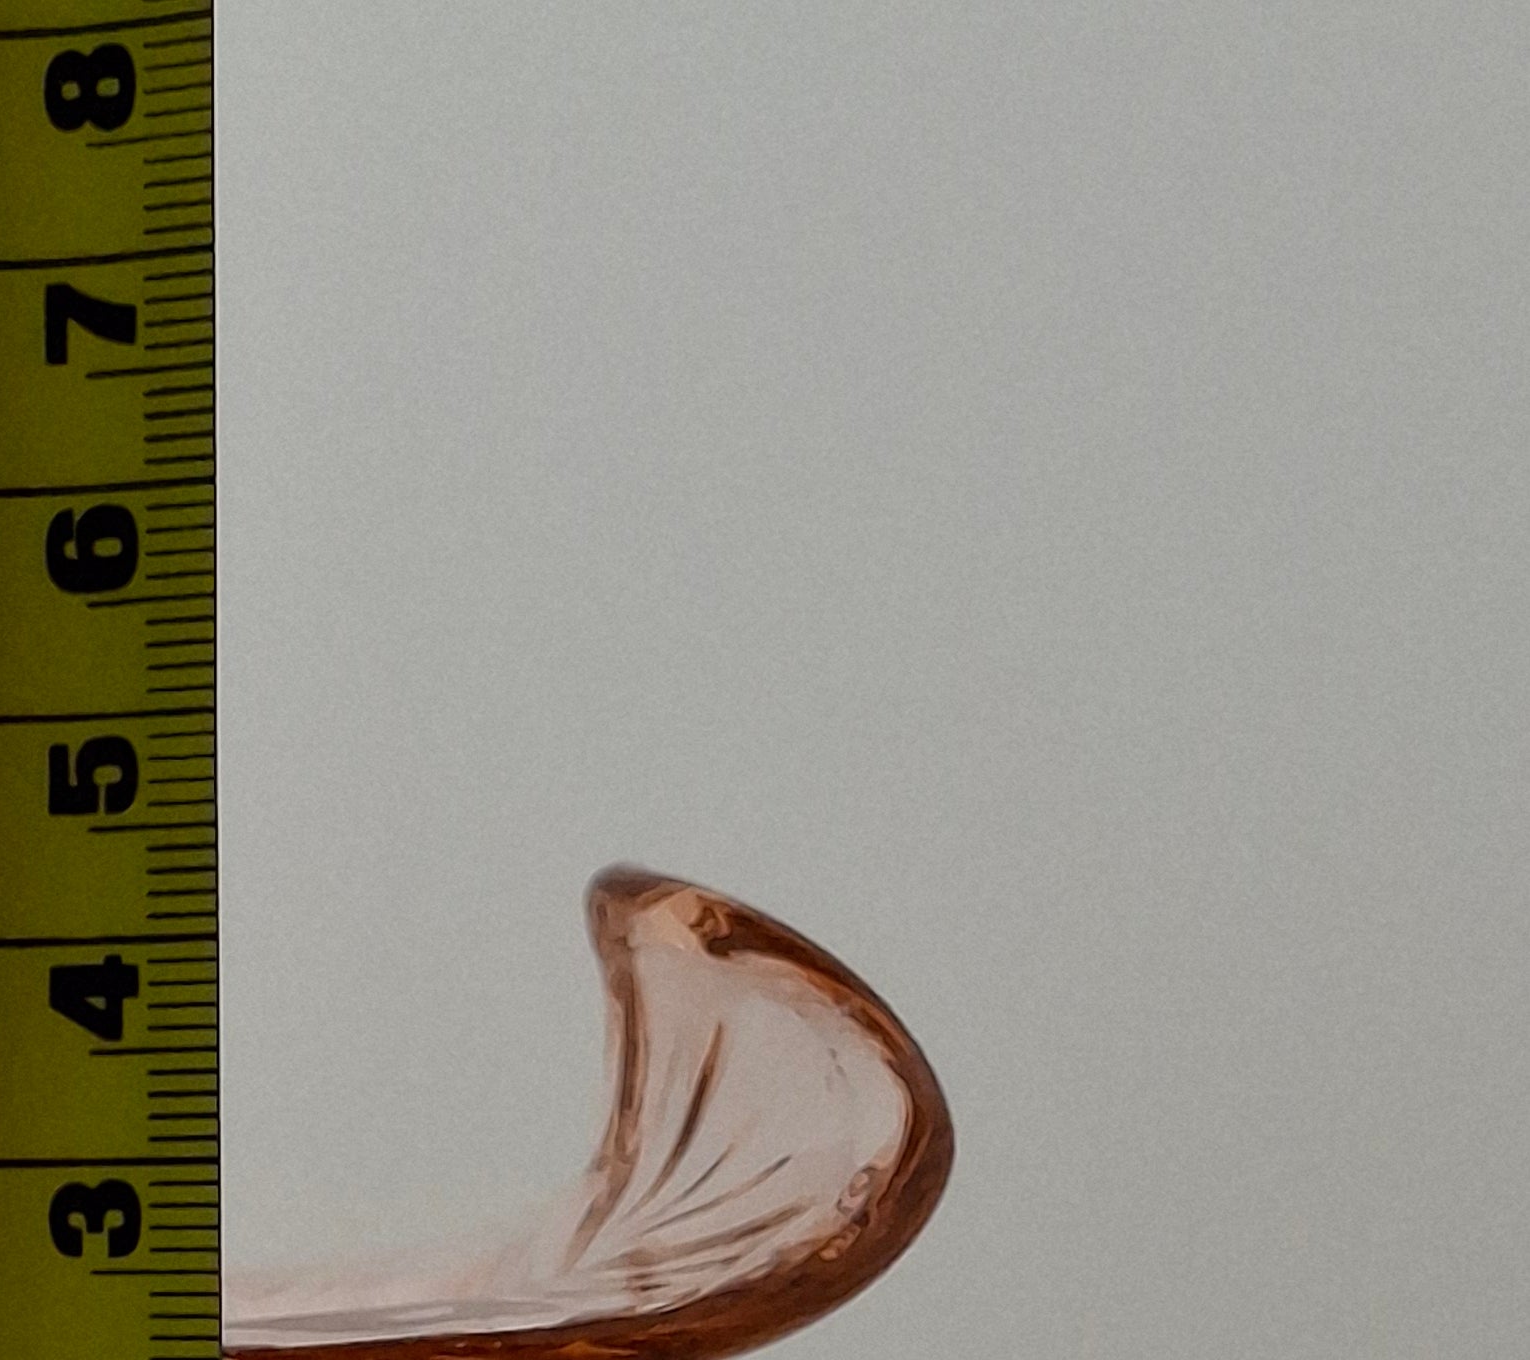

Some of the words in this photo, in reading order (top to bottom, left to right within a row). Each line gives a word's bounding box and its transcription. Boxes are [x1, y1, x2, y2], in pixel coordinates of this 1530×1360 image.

[43, 42, 137, 133] 8
[43, 282, 138, 366] 7
[44, 503, 139, 595] 6
[48, 734, 139, 817] 5
[48, 953, 141, 1043] 4
[48, 1177, 143, 1259] 3
